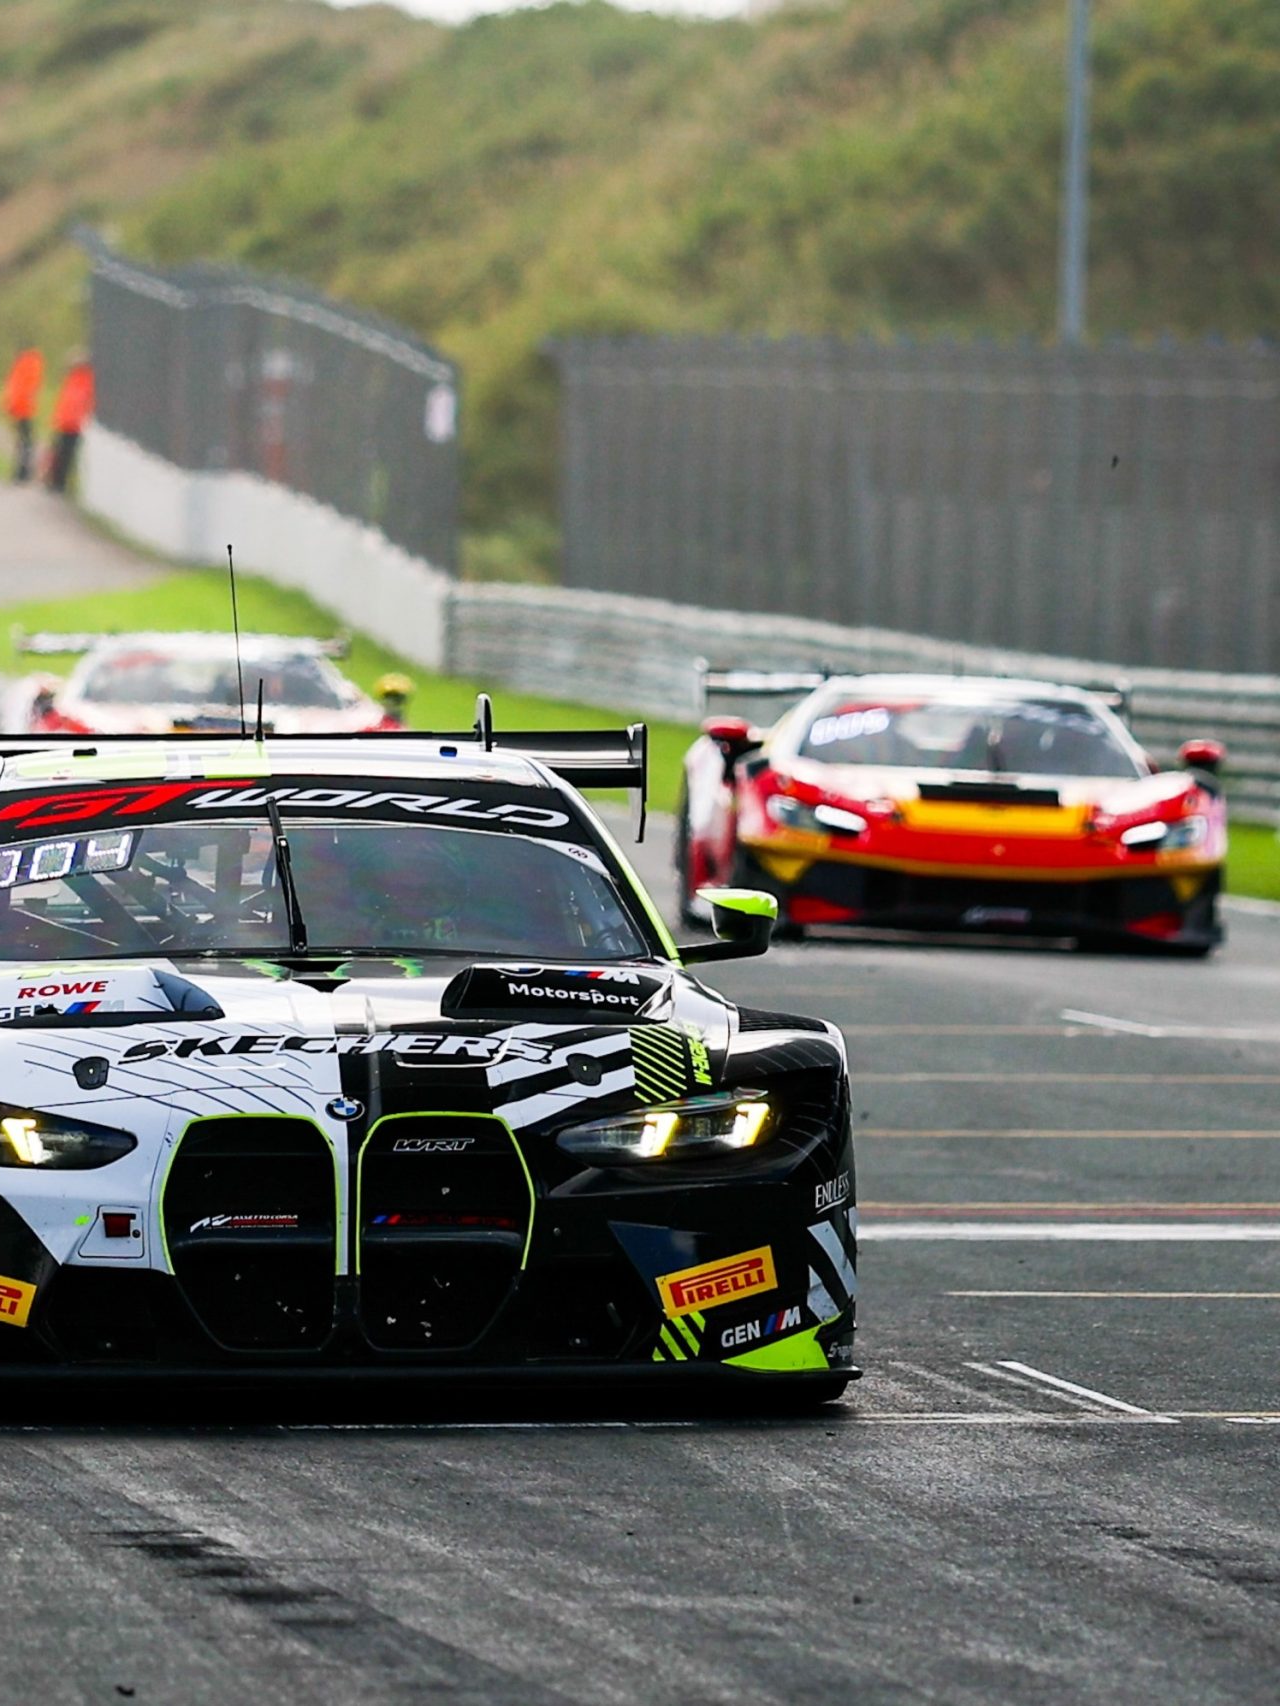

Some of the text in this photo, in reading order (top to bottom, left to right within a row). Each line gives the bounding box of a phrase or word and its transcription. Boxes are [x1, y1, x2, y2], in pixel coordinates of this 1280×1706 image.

[186, 787, 570, 830] WORLD
[17, 980, 109, 999] ROWE
[507, 982, 640, 1007] Motorsport
[117, 1032, 553, 1065] SKECHERS
[393, 1138, 475, 1151] WRT
[669, 1256, 766, 1309] PIRELLI
[721, 1318, 762, 1348] GEN
